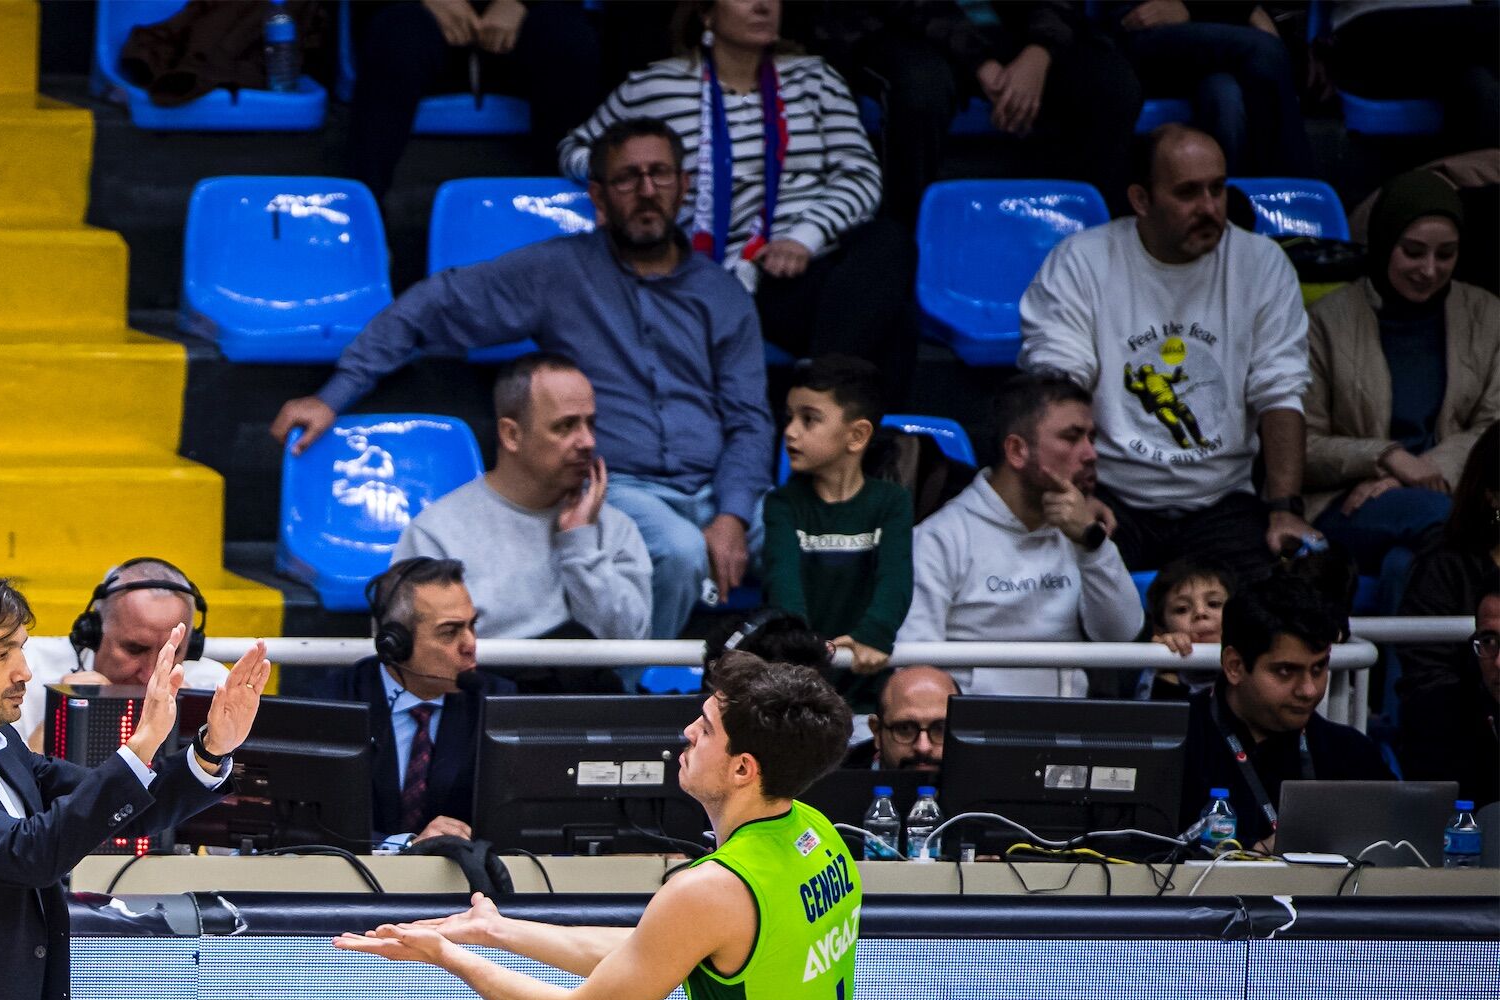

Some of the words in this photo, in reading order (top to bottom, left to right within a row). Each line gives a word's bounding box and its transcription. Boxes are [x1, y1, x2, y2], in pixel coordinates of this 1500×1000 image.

[1127, 325, 1158, 351] Feel
[1162, 321, 1184, 336] the
[1189, 322, 1217, 346] fear
[1129, 438, 1147, 455] do
[800, 849, 854, 924] CENGİZ
